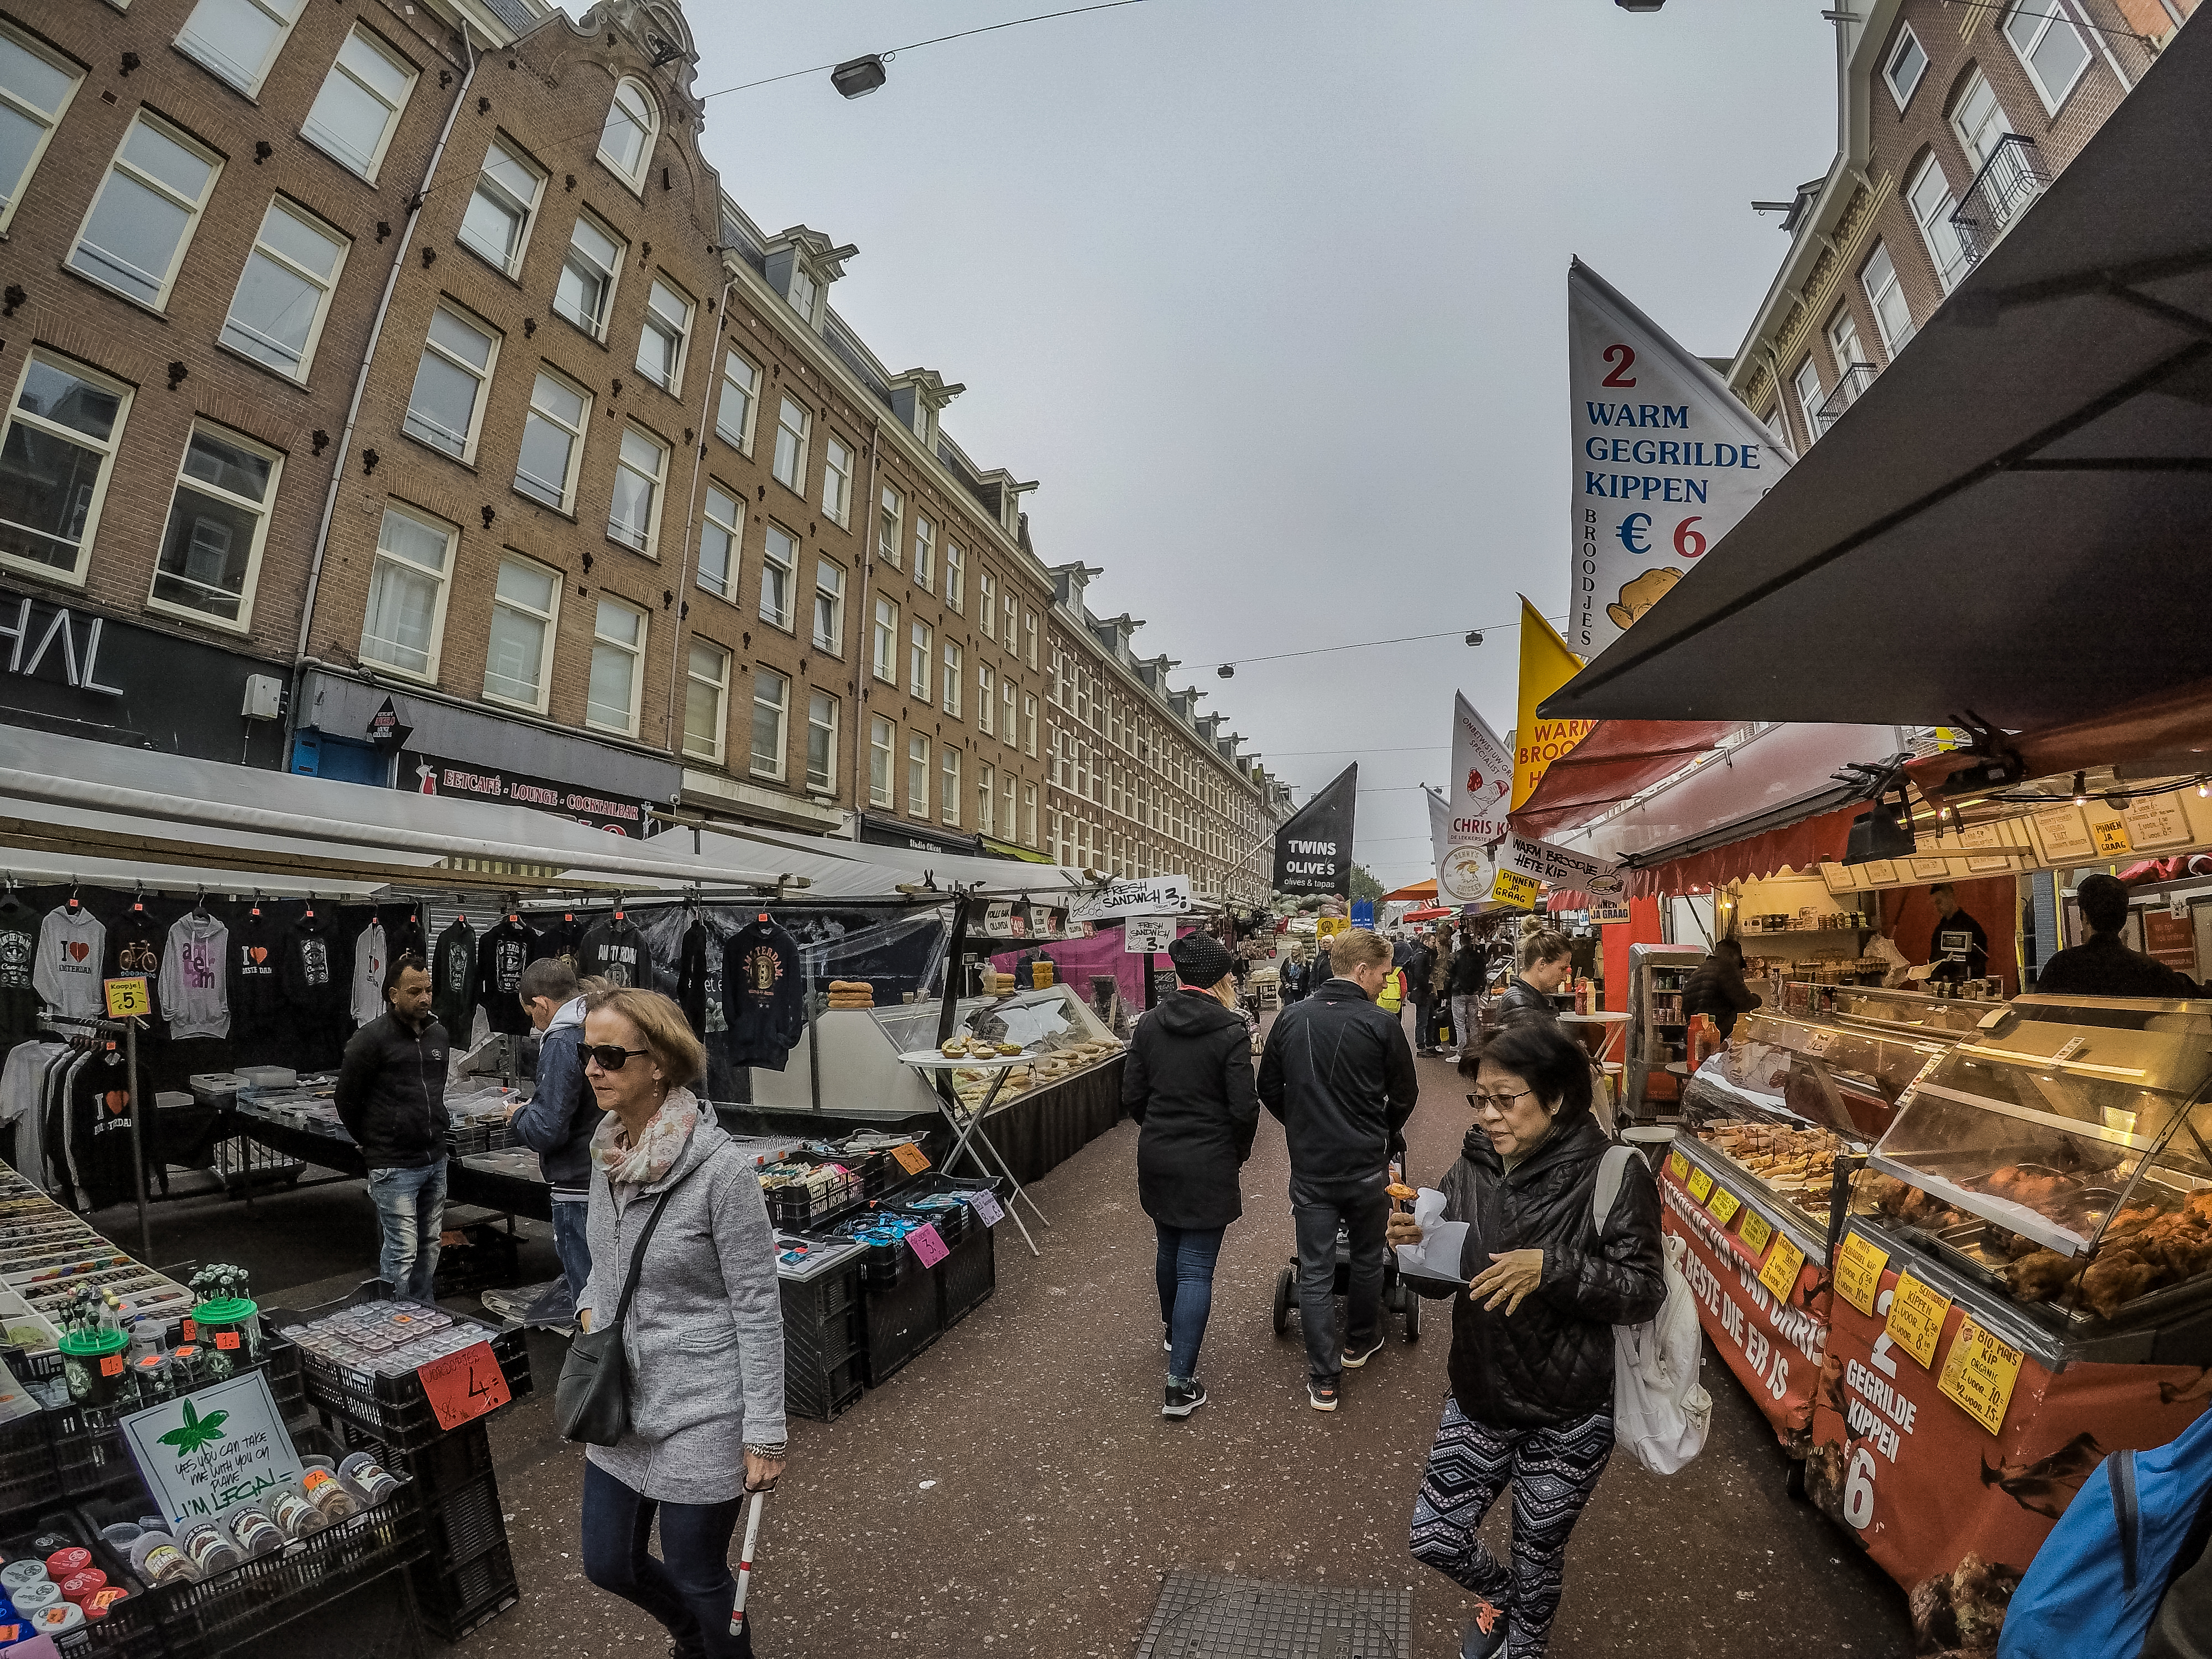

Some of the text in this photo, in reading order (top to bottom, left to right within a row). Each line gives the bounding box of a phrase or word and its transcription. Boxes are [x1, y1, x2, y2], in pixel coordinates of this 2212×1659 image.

[1601, 344, 1636, 388] 2
[1585, 401, 1689, 429] WARM
[1585, 436, 1761, 469] GEGRILDE
[1585, 471, 1709, 504] KIPPEN
[1673, 516, 1707, 558] 6
[1581, 508, 1597, 646] BROODJES
[1463, 717, 1493, 753] ONBETWIST
[1491, 752, 1504, 764] UW
[1469, 739, 1500, 775] SPECIALIST
[1520, 740, 1577, 765] BROO
[444, 769, 639, 820] EETCAFÉ LOUNGE COCKTAILBAR
[1453, 818, 1492, 835] CHRIS
[1288, 840, 1337, 855] TWINS
[1513, 837, 1598, 876] WARM BROODJE
[2101, 841, 2126, 851] GRAAG
[1514, 854, 1568, 879] HETE KIP
[1103, 881, 1147, 897] FRESH
[1284, 878, 1305, 886] olives
[1314, 880, 1335, 889] tapas
[1495, 886, 1526, 903] GRAAG
[1508, 883, 1519, 893] JA
[1103, 889, 1160, 908] SANDWICH
[1590, 909, 1601, 920] JA
[1602, 908, 1628, 919] GRAAG
[1130, 929, 1171, 940] SANDWICH
[1137, 922, 1164, 930] FRESH
[61, 940, 67, 962] I
[242, 946, 249, 965] I
[111, 981, 141, 990] Koopje!
[95, 1093, 104, 1120] I
[1685, 1248, 1789, 1401] BESTE DIE ER IS
[1977, 1329, 1995, 1349] BIO
[1970, 1357, 1999, 1383] ORGANIC
[1846, 1358, 1917, 1435] GEGRILDE
[1847, 1396, 1901, 1464] KIPPEN
[175, 1432, 268, 1480] YES YOU CAN TAKE
[190, 1446, 270, 1486] ME WITH YOU ON
[353, 1460, 369, 1472] SPACE
[210, 1470, 240, 1493] PLANE
[181, 1496, 212, 1518] I'M
[231, 1509, 247, 1528] SPACE
[194, 1524, 212, 1533] CAKE
